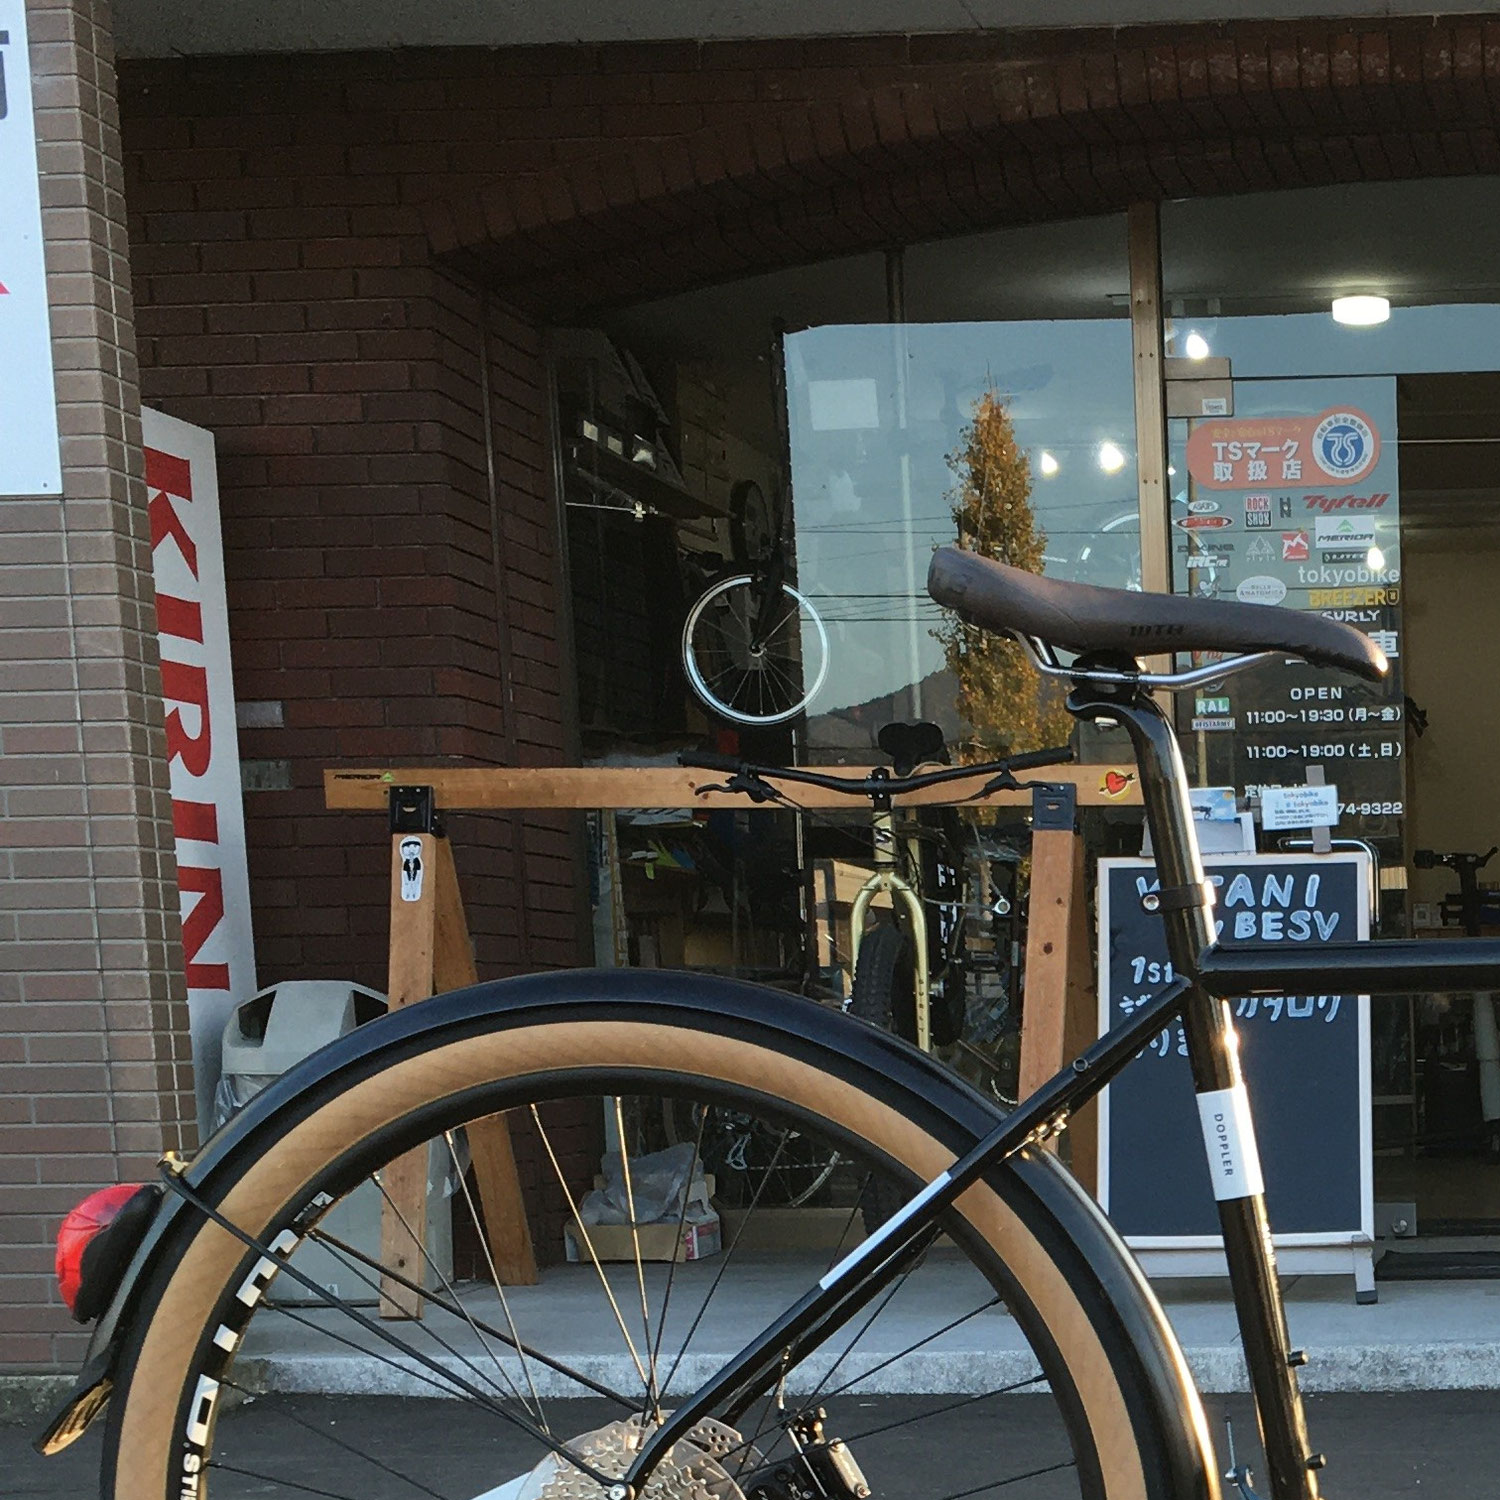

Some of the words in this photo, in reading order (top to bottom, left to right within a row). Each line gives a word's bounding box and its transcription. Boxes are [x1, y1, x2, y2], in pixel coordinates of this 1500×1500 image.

[1211, 439, 1299, 461] TSマーク
[1213, 459, 1302, 482] 取扱店
[1246, 497, 1270, 512] ROCK
[1247, 512, 1271, 526] SHOX
[1317, 533, 1374, 543] MERIDA
[1298, 566, 1400, 587] tokyobike
[1309, 588, 1387, 608] BREEZER
[1290, 686, 1343, 701] OPEN
[1337, 801, 1404, 816] 74-9322
[1234, 910, 1340, 942] BESV
[1213, 1112, 1234, 1177] DOPPLER
